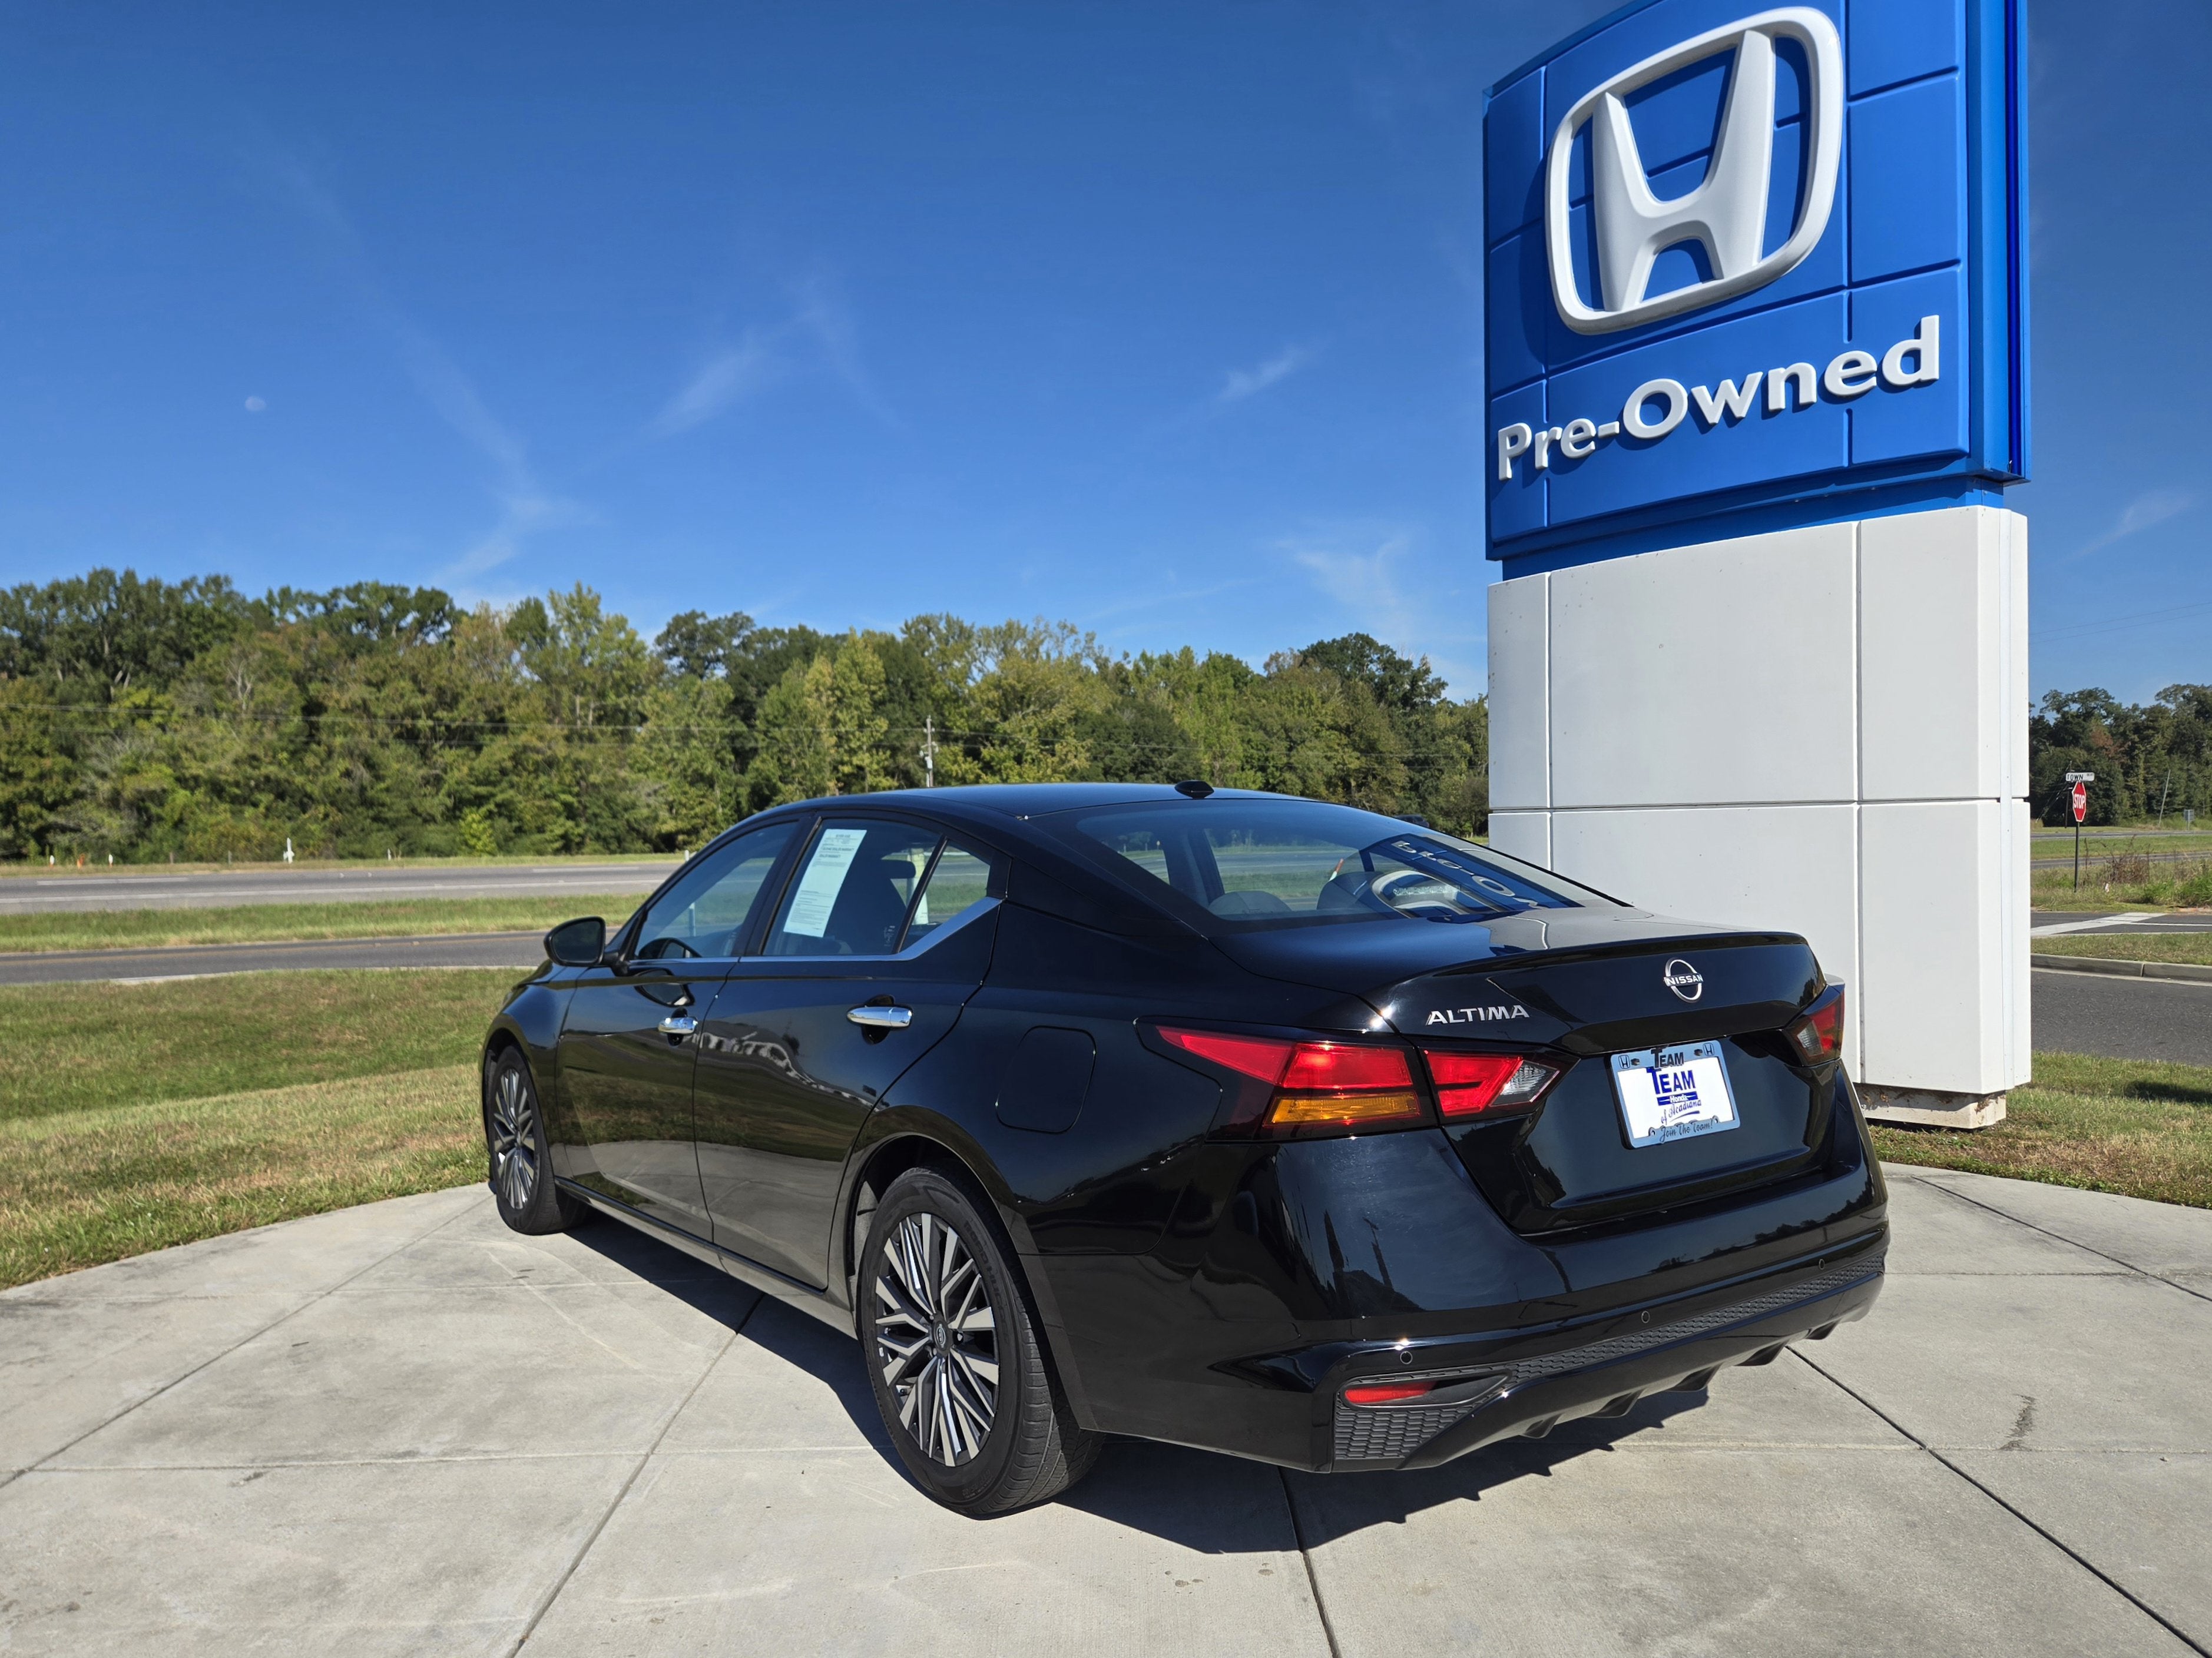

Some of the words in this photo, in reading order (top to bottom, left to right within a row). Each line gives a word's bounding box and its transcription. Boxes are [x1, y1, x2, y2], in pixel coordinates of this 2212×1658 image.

[1498, 314, 1939, 481] Pre-Owned
[2074, 793, 2085, 810] STOP
[1665, 973, 1703, 986] NISSAN
[1426, 1004, 1530, 1026] ALTIMA
[1651, 1047, 1684, 1068] TEAM
[1646, 1067, 1696, 1095] TEAM
[1670, 1093, 1688, 1103] Honda
[1660, 1109, 1667, 1125] of
[1660, 1126, 1677, 1143] Join
[1677, 1123, 1691, 1136] The
[1690, 1120, 1714, 1134] Team!
